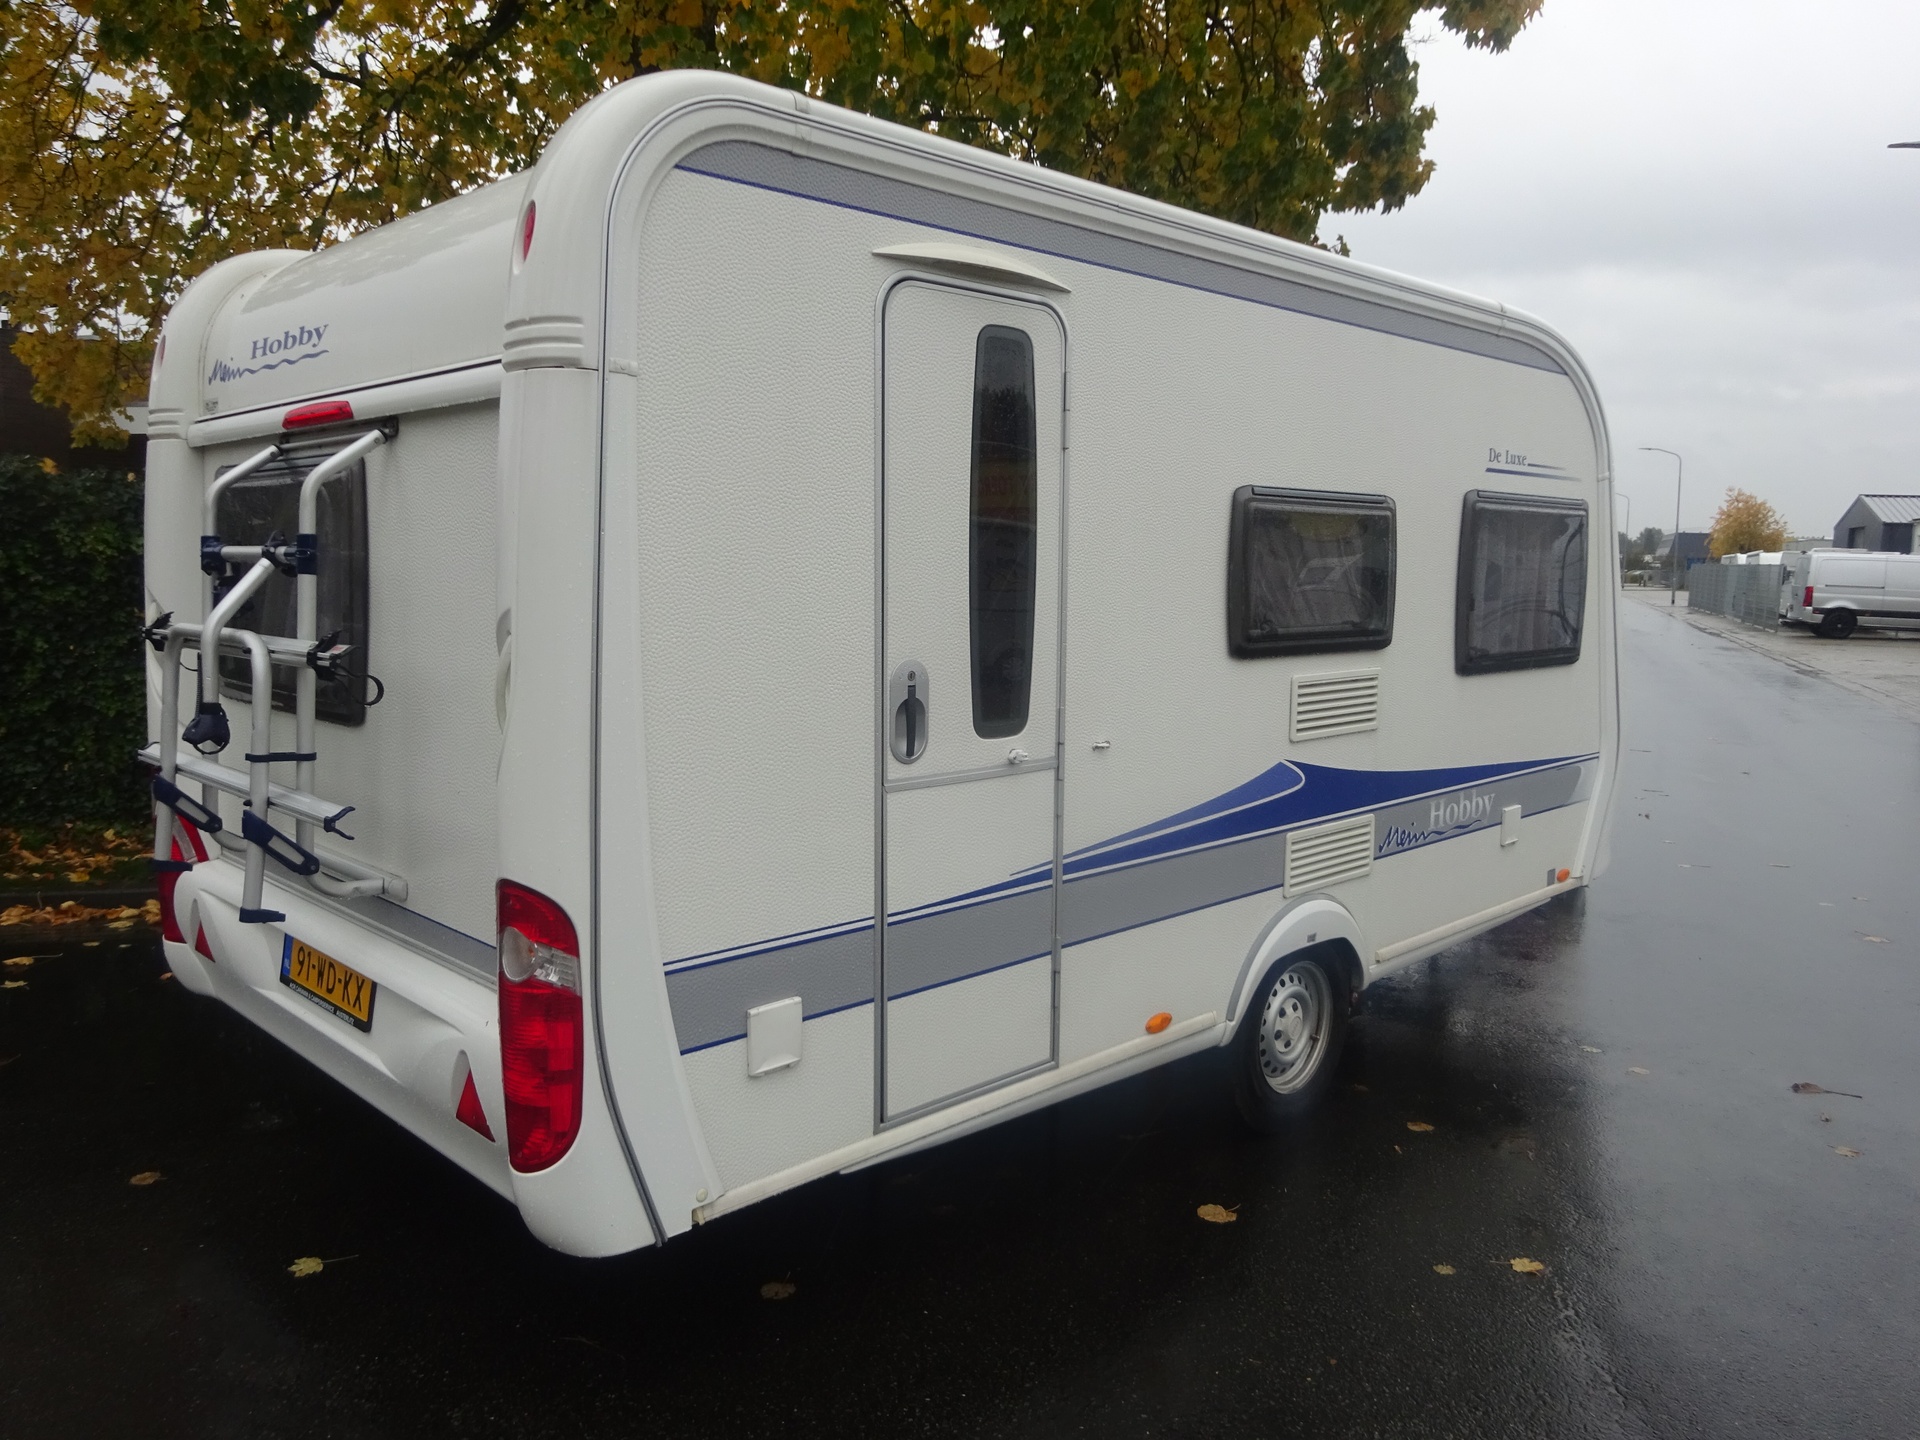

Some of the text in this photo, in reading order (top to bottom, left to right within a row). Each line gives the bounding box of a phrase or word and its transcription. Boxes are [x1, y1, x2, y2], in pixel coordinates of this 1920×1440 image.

[208, 324, 329, 386] Mein Hobby
[1488, 447, 1527, 466] De Luxe
[1379, 789, 1496, 853] Mein Hobby
[297, 945, 366, 1012] 91-WD-KX
